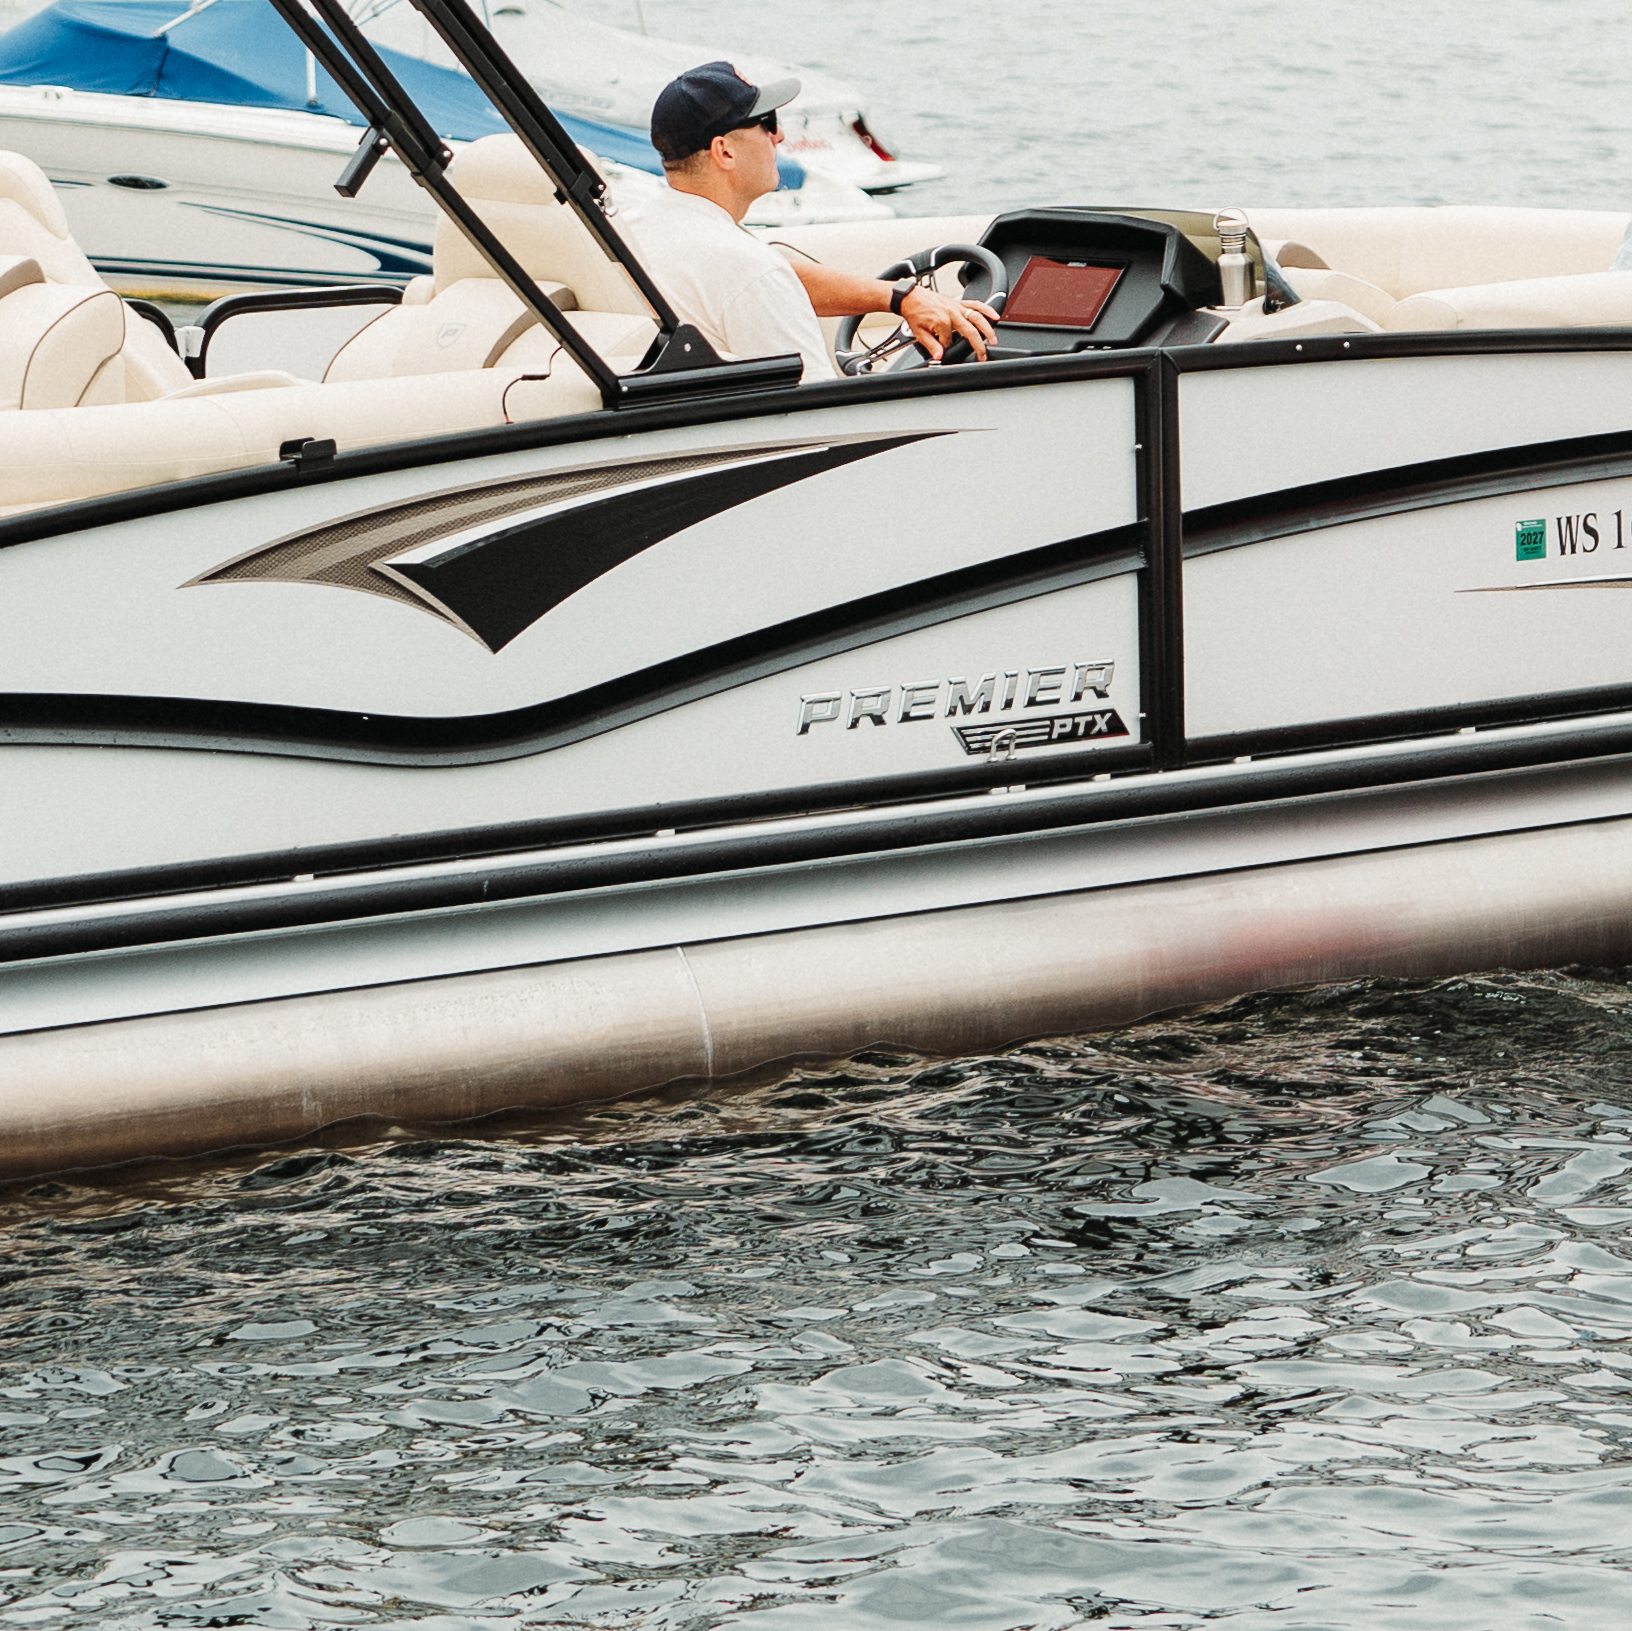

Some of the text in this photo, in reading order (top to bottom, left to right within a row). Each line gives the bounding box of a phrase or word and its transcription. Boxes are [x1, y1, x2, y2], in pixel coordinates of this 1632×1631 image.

[1520, 531, 1544, 546] 2027
[1556, 512, 1600, 556] WS
[796, 658, 1115, 735] PREMIER
[1051, 712, 1113, 740] PTX
